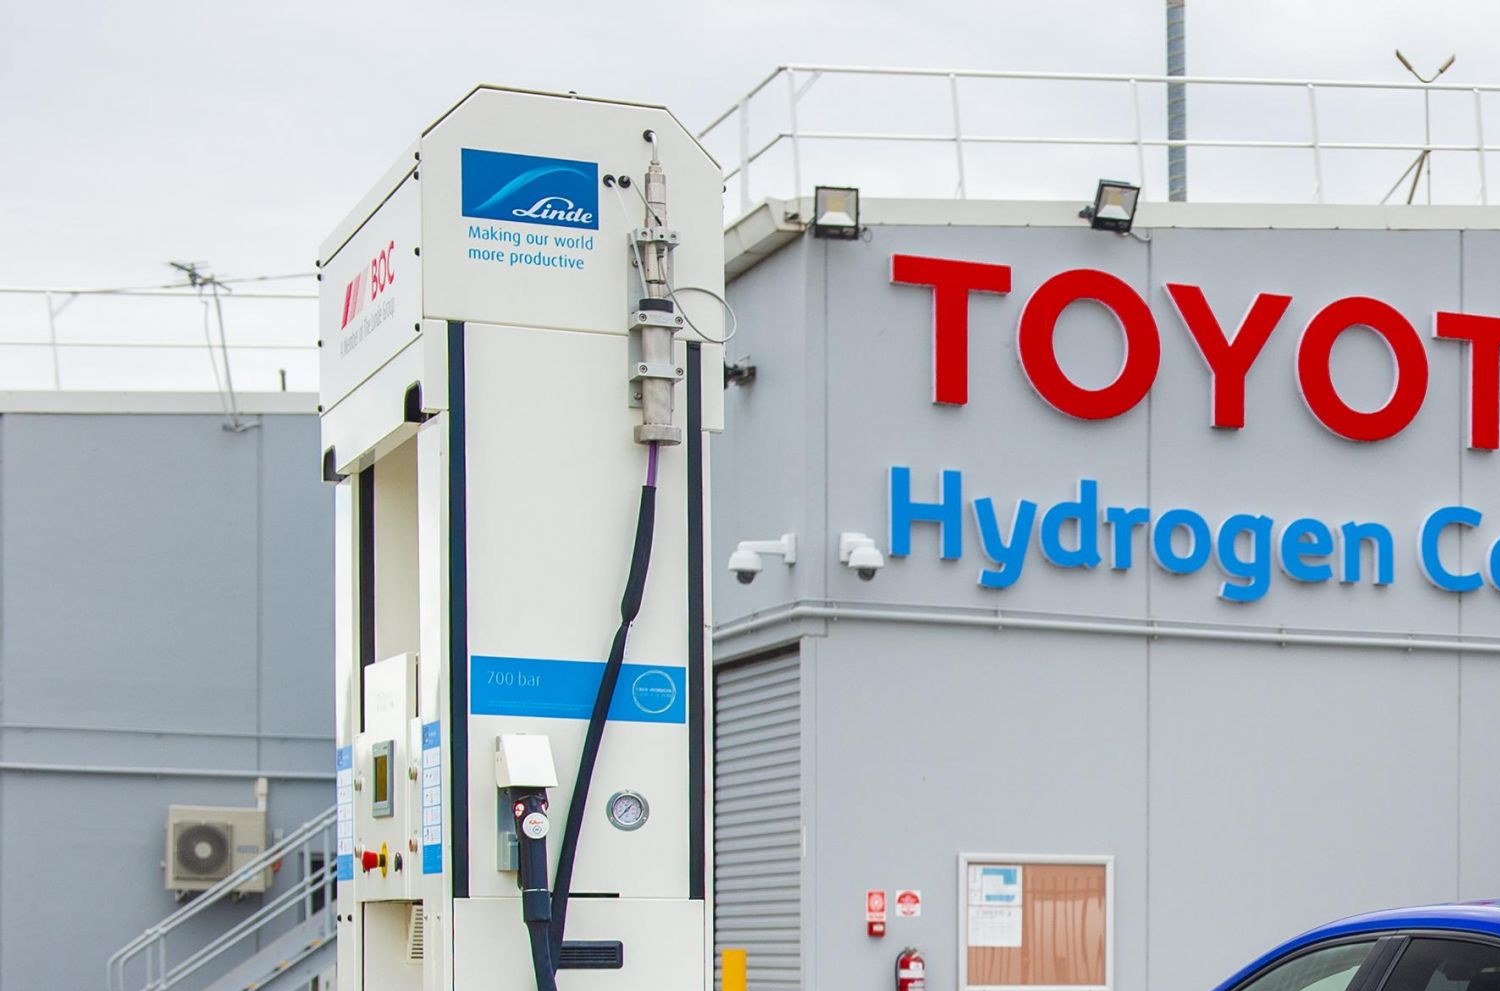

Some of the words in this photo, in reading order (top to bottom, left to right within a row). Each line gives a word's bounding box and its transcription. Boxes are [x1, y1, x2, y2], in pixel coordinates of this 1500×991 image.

[512, 196, 593, 224] Linde
[468, 225, 521, 247] Making
[526, 233, 549, 245] our
[554, 236, 594, 251] world
[371, 239, 395, 301] BOC
[468, 247, 505, 262] more
[510, 251, 585, 270] productive
[887, 465, 1394, 602] Hydrogen
[487, 670, 514, 686] 700
[518, 671, 541, 688] bar
